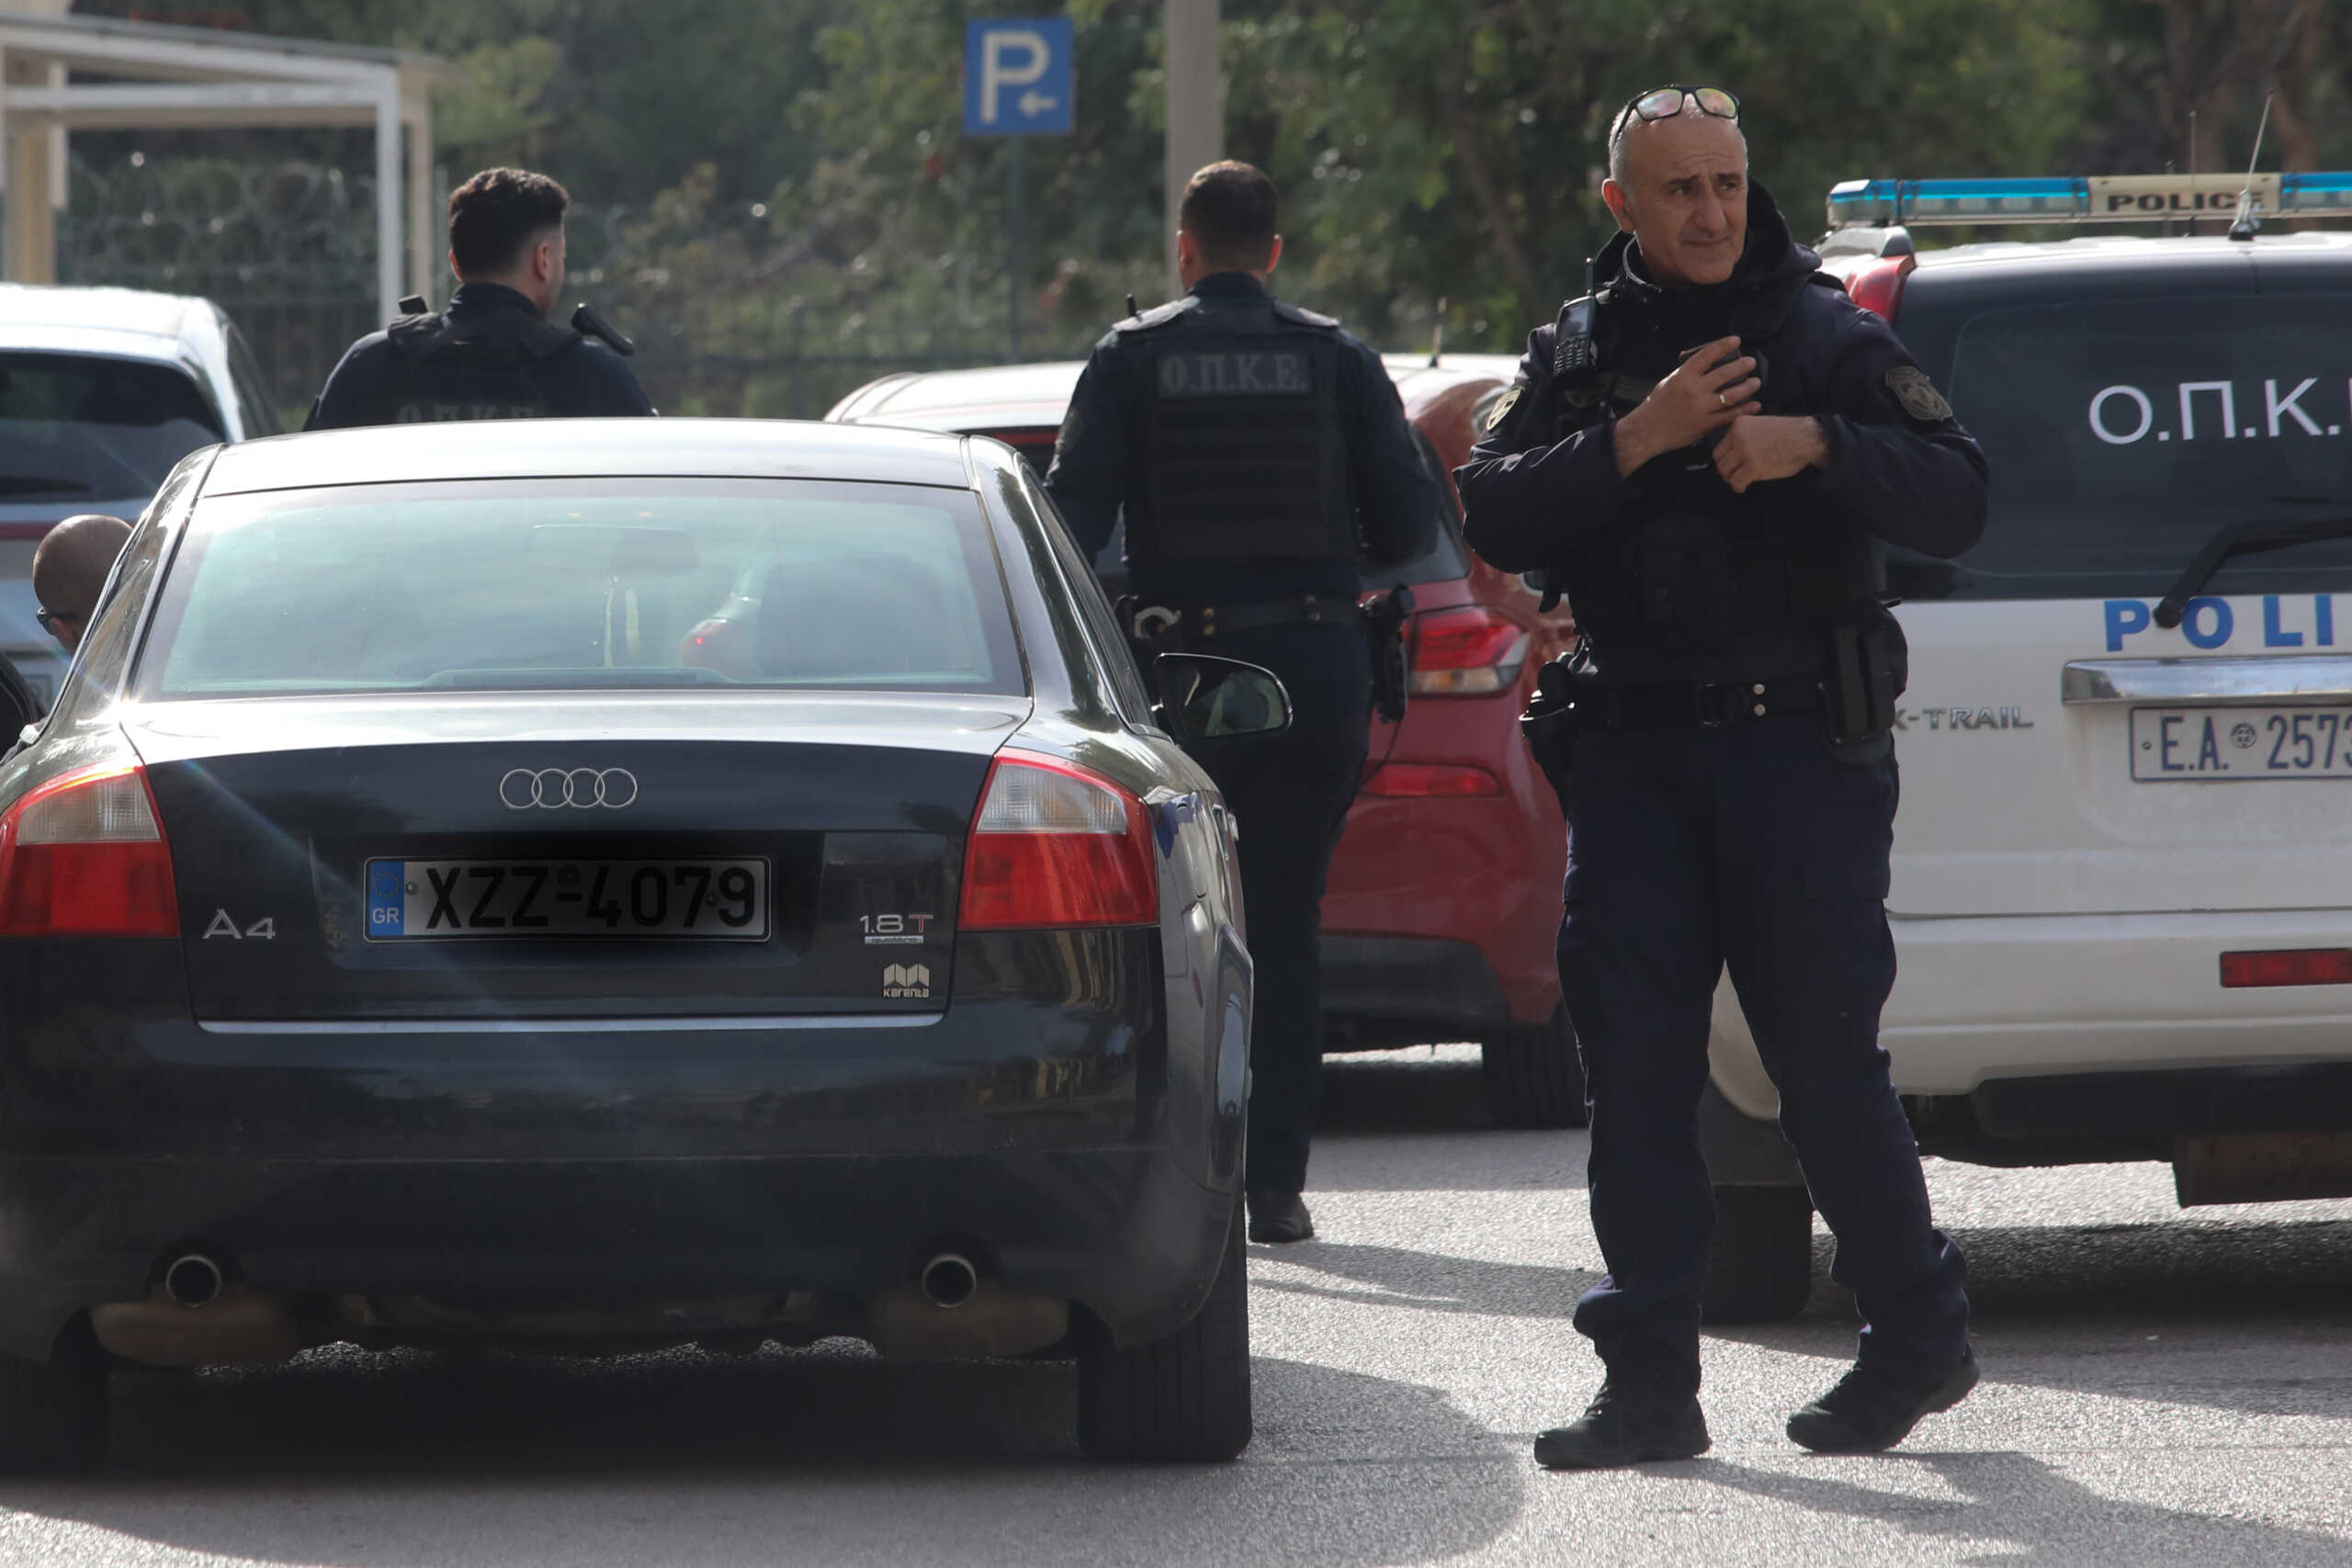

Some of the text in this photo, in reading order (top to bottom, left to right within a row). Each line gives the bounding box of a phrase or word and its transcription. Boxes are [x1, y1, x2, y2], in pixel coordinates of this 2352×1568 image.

[980, 30, 1050, 124] P
[2088, 377, 2352, 446] Ο.Π.Κ.
[2104, 593, 2335, 652] POLI
[203, 908, 276, 940] A4
[372, 908, 400, 924] GR
